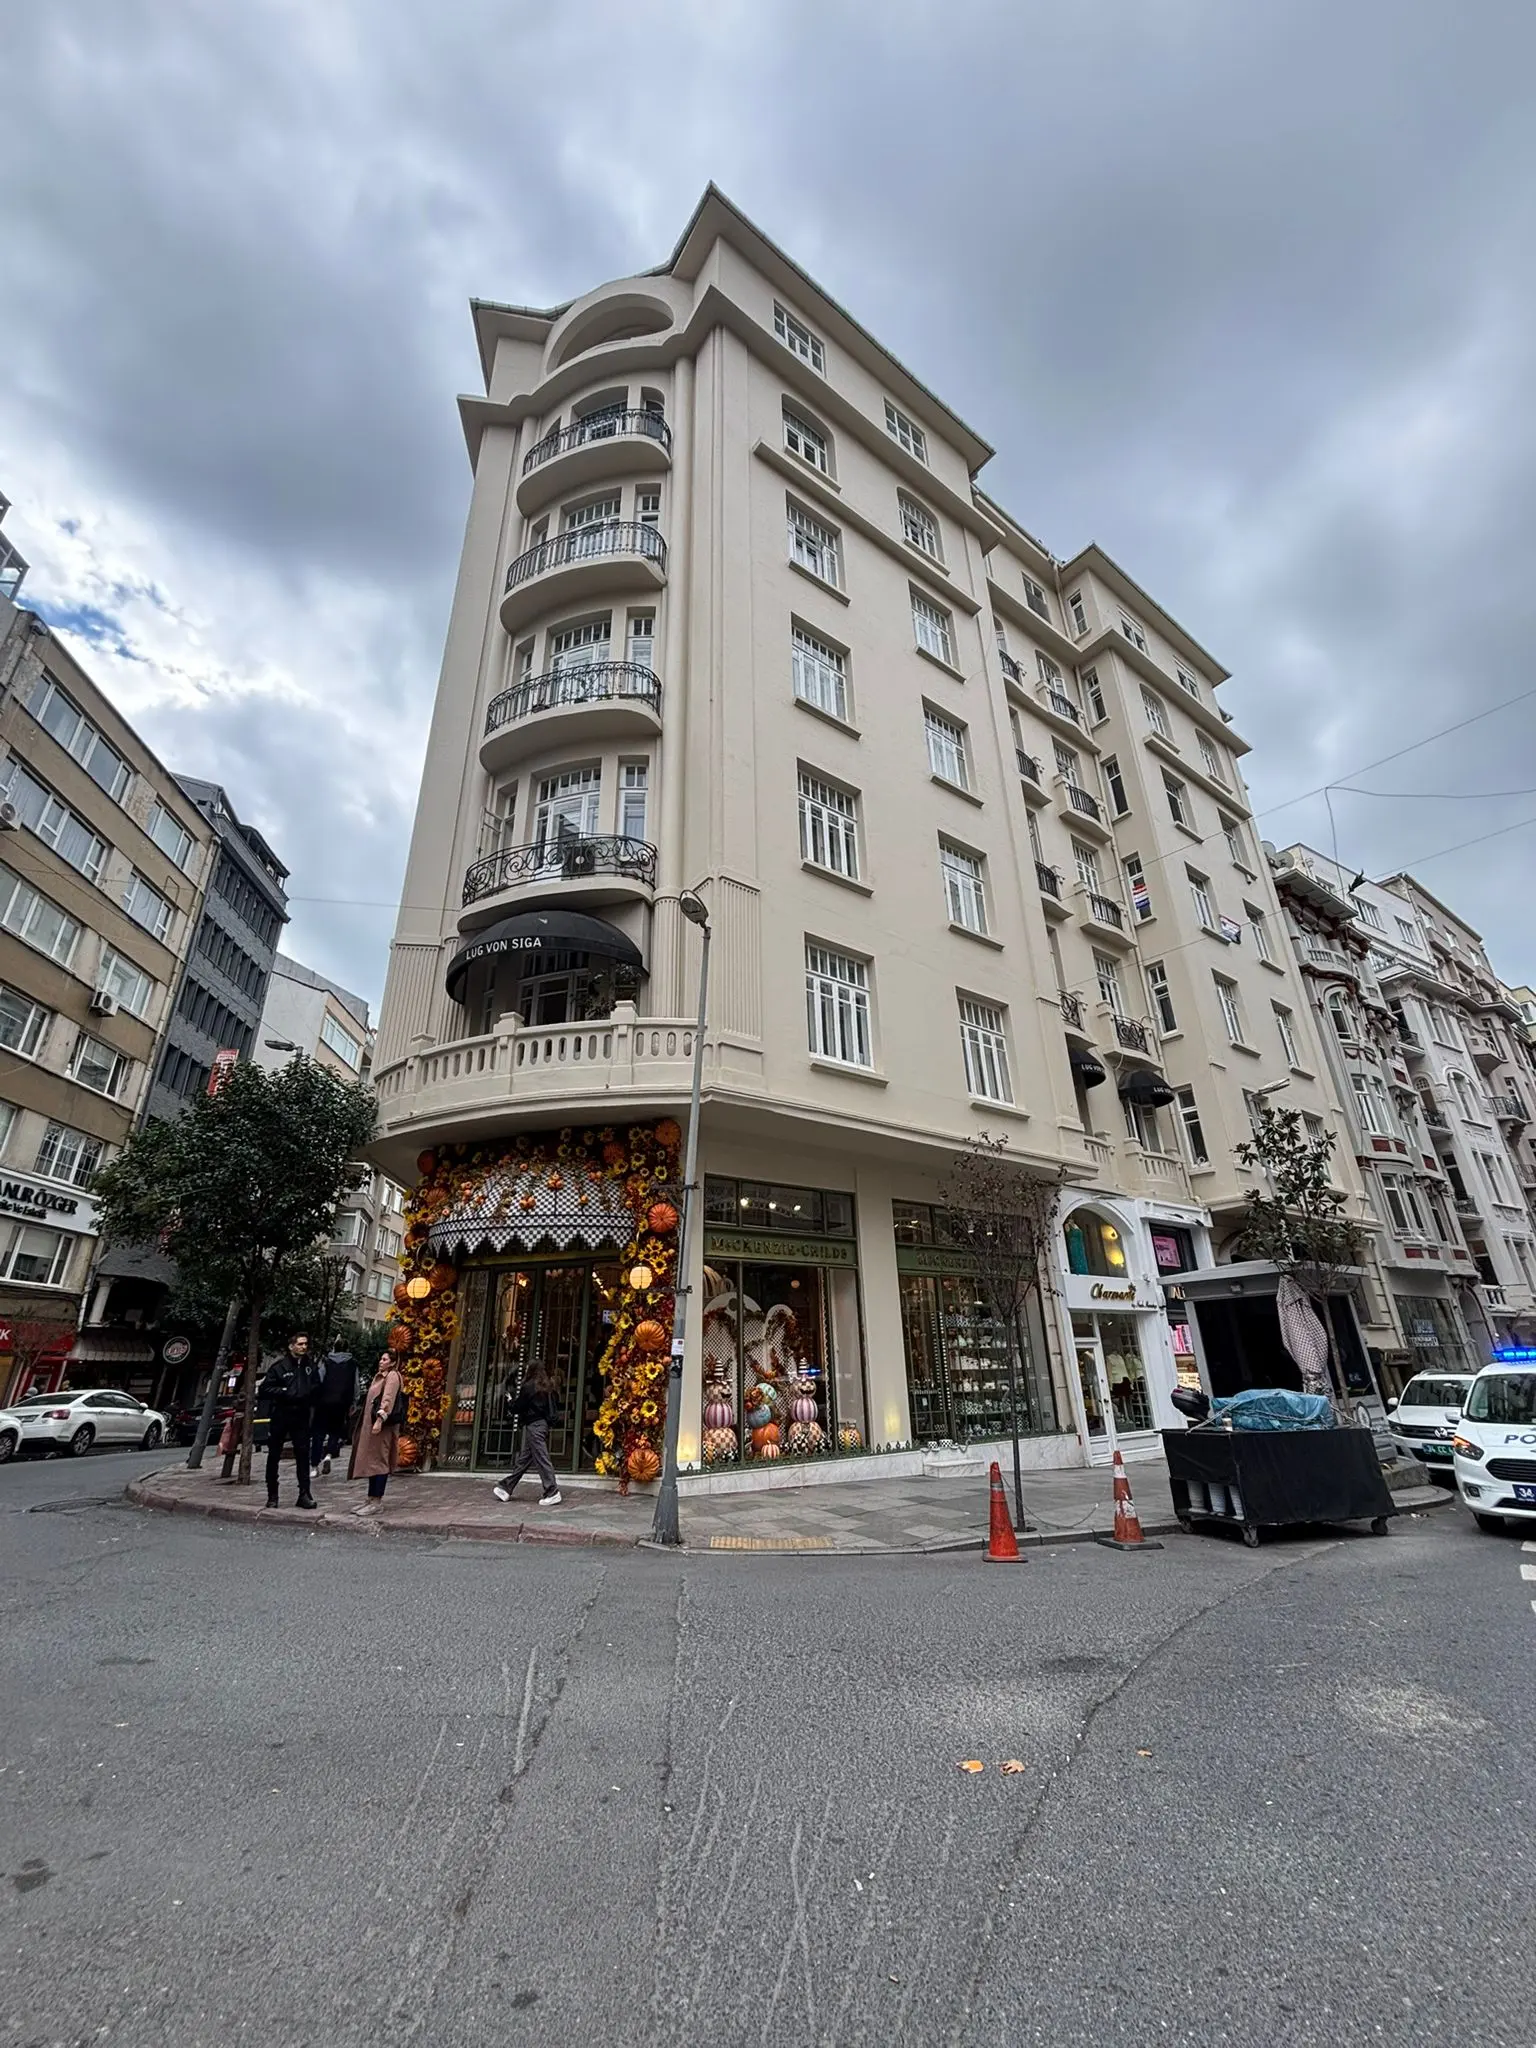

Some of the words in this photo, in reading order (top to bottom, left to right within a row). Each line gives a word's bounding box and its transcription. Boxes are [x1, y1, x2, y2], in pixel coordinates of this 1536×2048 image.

[466, 946, 484, 960] LUG
[486, 940, 508, 953] VON
[511, 937, 542, 949] SIGA
